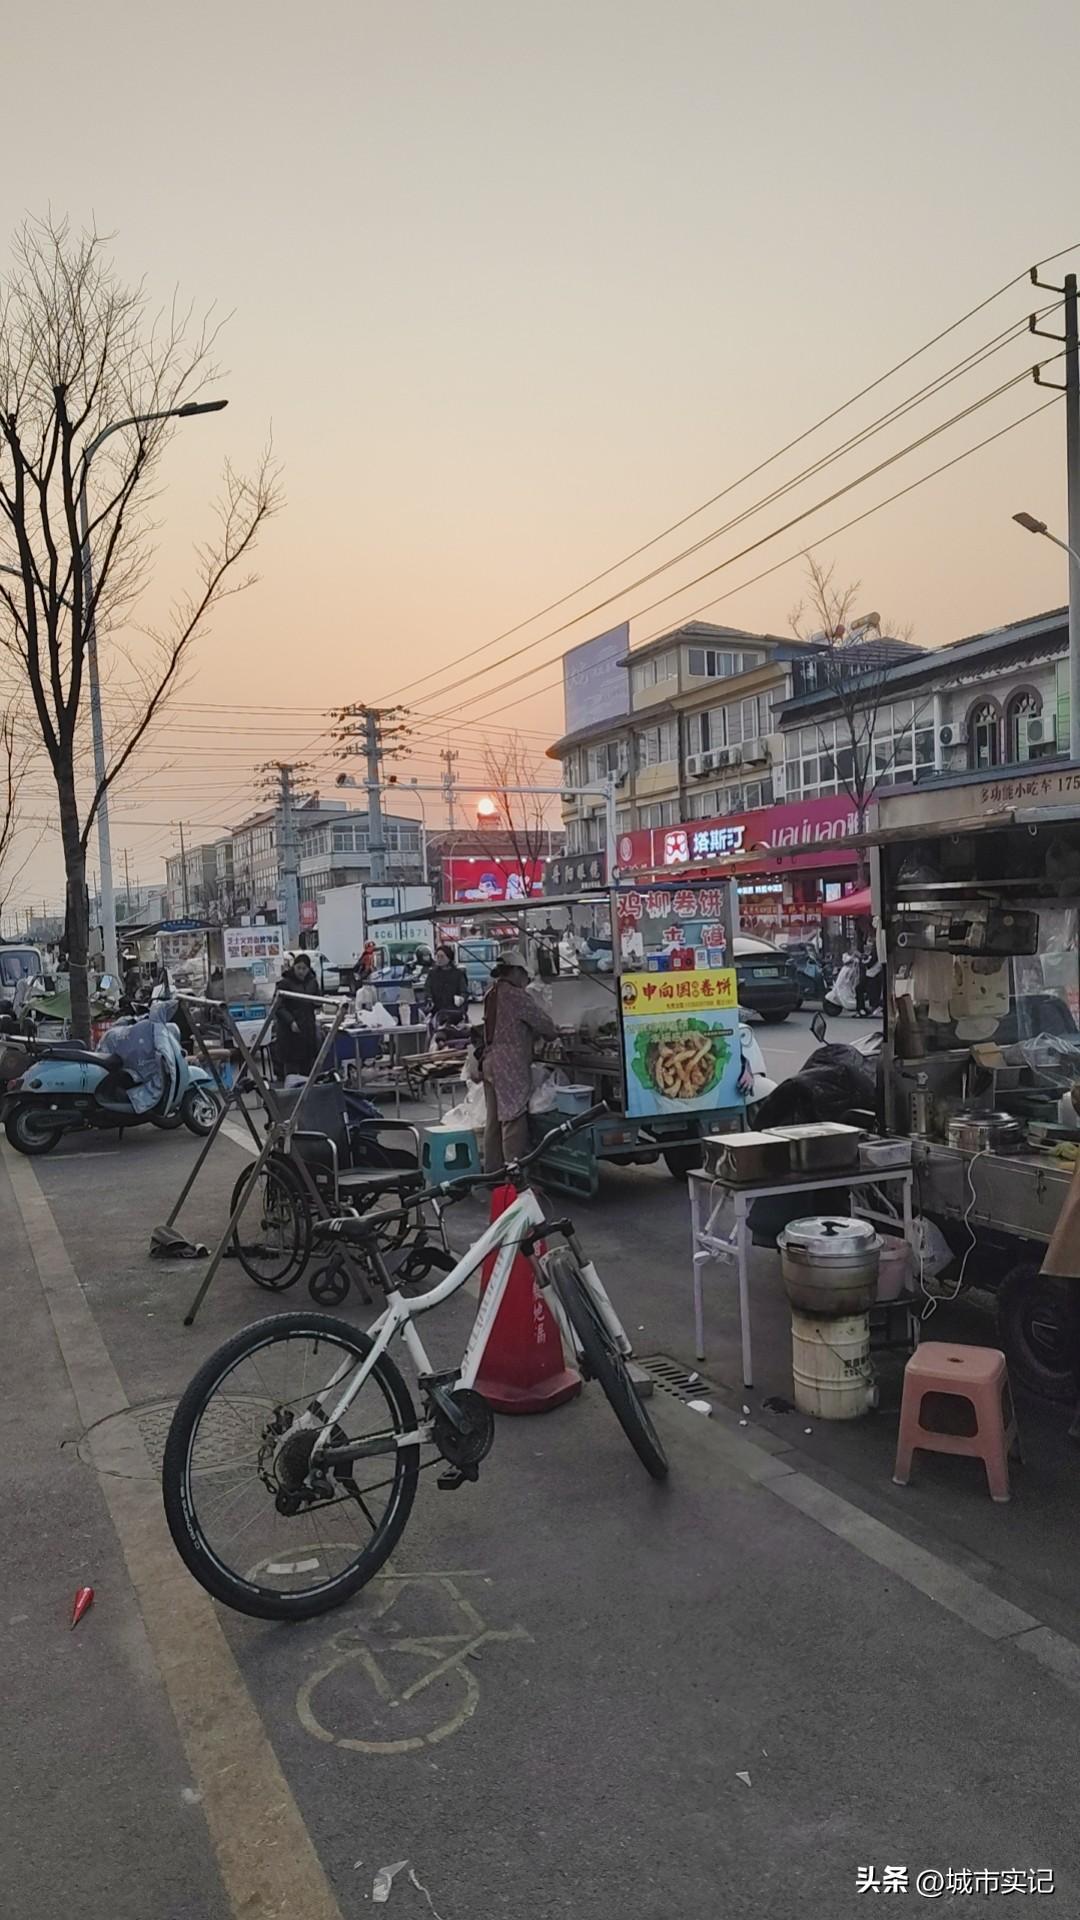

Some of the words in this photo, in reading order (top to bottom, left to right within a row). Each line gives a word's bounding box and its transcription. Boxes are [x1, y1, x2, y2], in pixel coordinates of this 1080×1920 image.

[982, 778, 1051, 803] 多功能小吃车
[693, 825, 746, 853] 塔斯汀
[617, 888, 723, 919] 鸡柳卷饼
